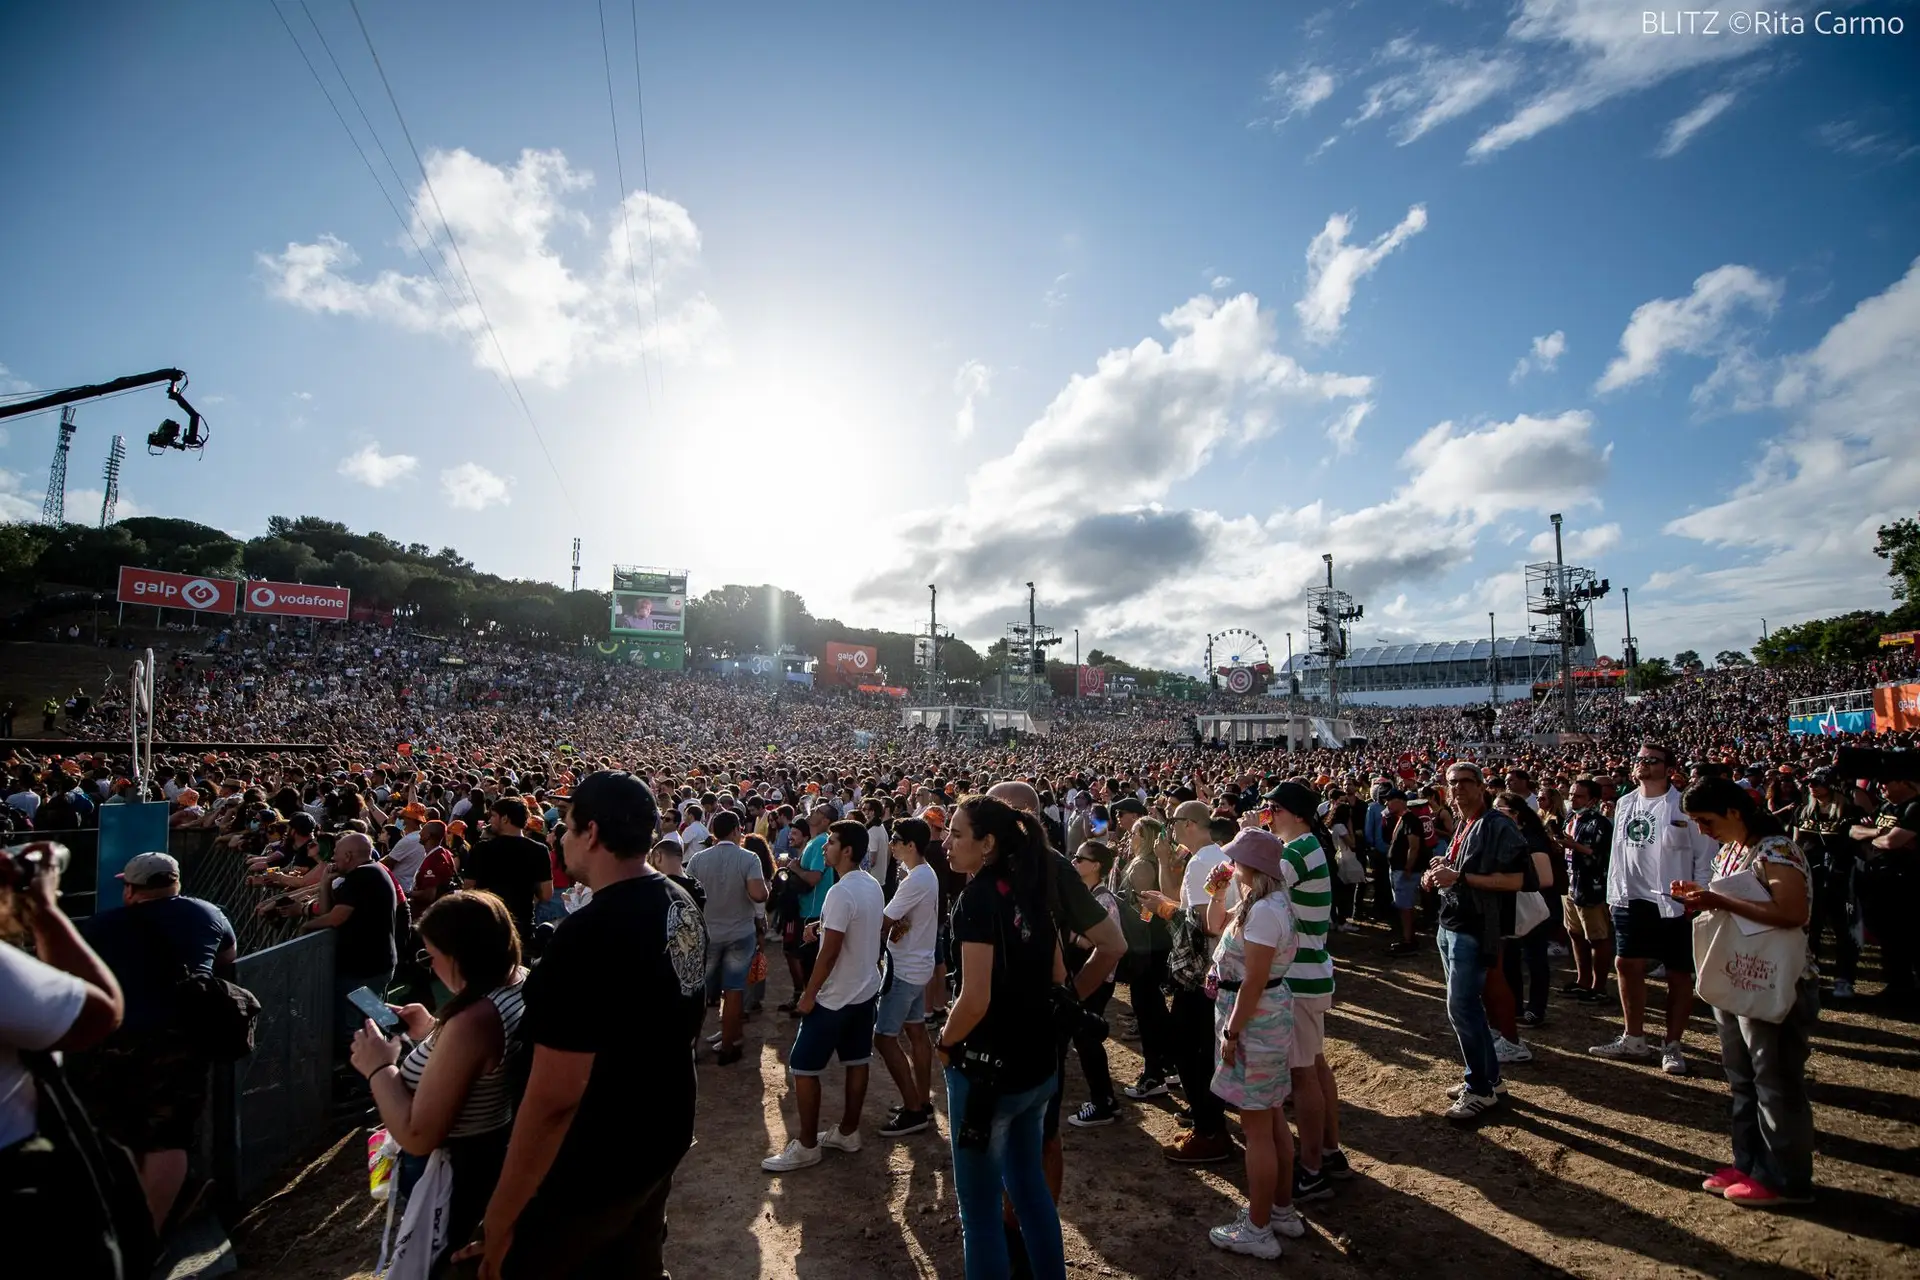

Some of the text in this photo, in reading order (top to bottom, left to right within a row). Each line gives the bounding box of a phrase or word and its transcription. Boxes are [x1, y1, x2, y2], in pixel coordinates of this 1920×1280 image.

[134, 580, 178, 597] galp
[279, 593, 344, 608] vodafone
[837, 652, 854, 662] galp
